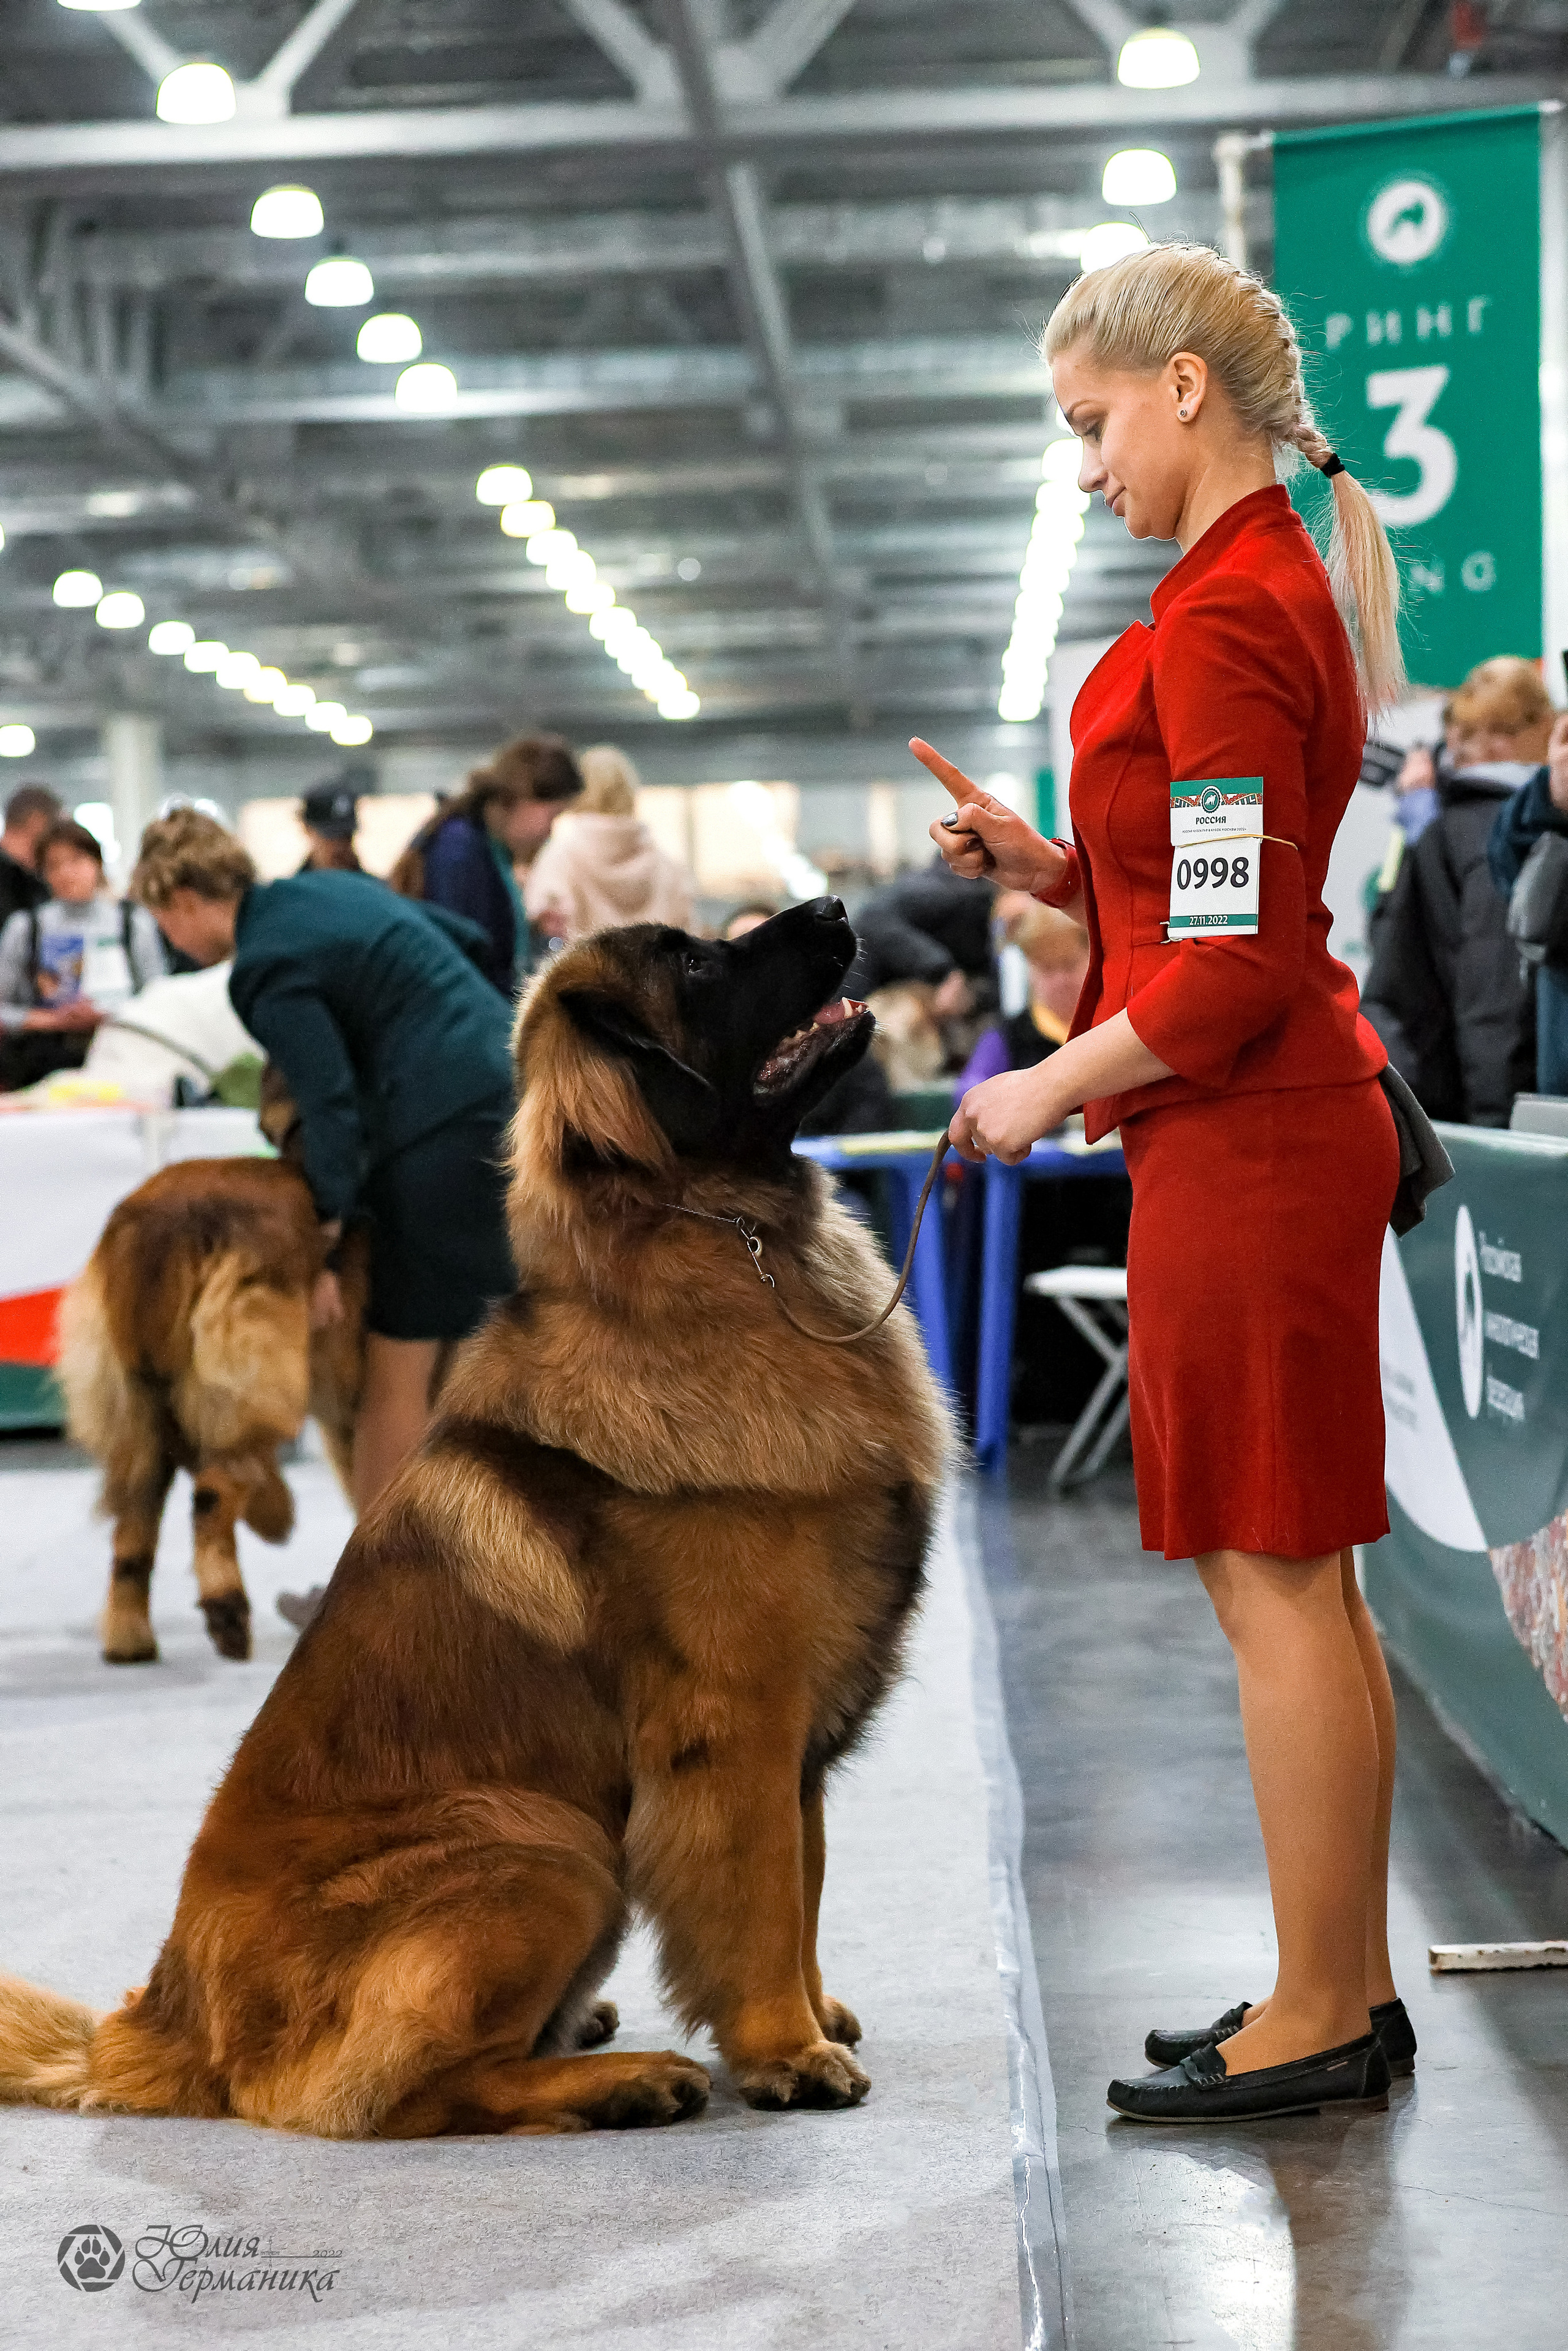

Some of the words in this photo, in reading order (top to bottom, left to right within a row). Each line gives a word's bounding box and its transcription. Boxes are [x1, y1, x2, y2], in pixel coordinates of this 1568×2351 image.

[1325, 294, 1491, 351] РИНГ
[1366, 364, 1457, 527] 3
[1196, 816, 1226, 825] РОССИЯ
[1177, 856, 1250, 890] 0998
[1189, 916, 1228, 926] 27.11.2022
